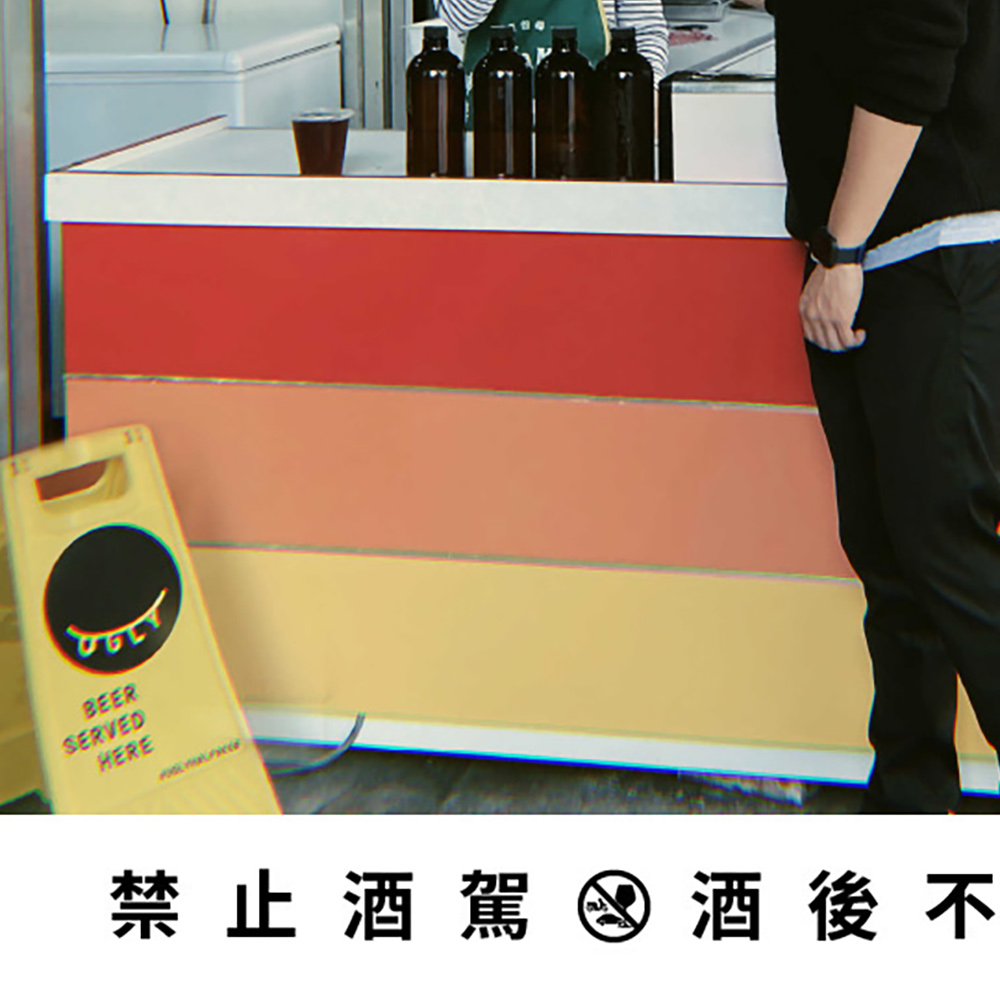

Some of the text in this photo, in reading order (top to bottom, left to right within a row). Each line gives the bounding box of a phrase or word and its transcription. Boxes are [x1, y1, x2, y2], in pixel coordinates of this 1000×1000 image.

[82, 683, 139, 720] BEER
[62, 710, 146, 756] SERVED
[98, 736, 154, 772] HERE
